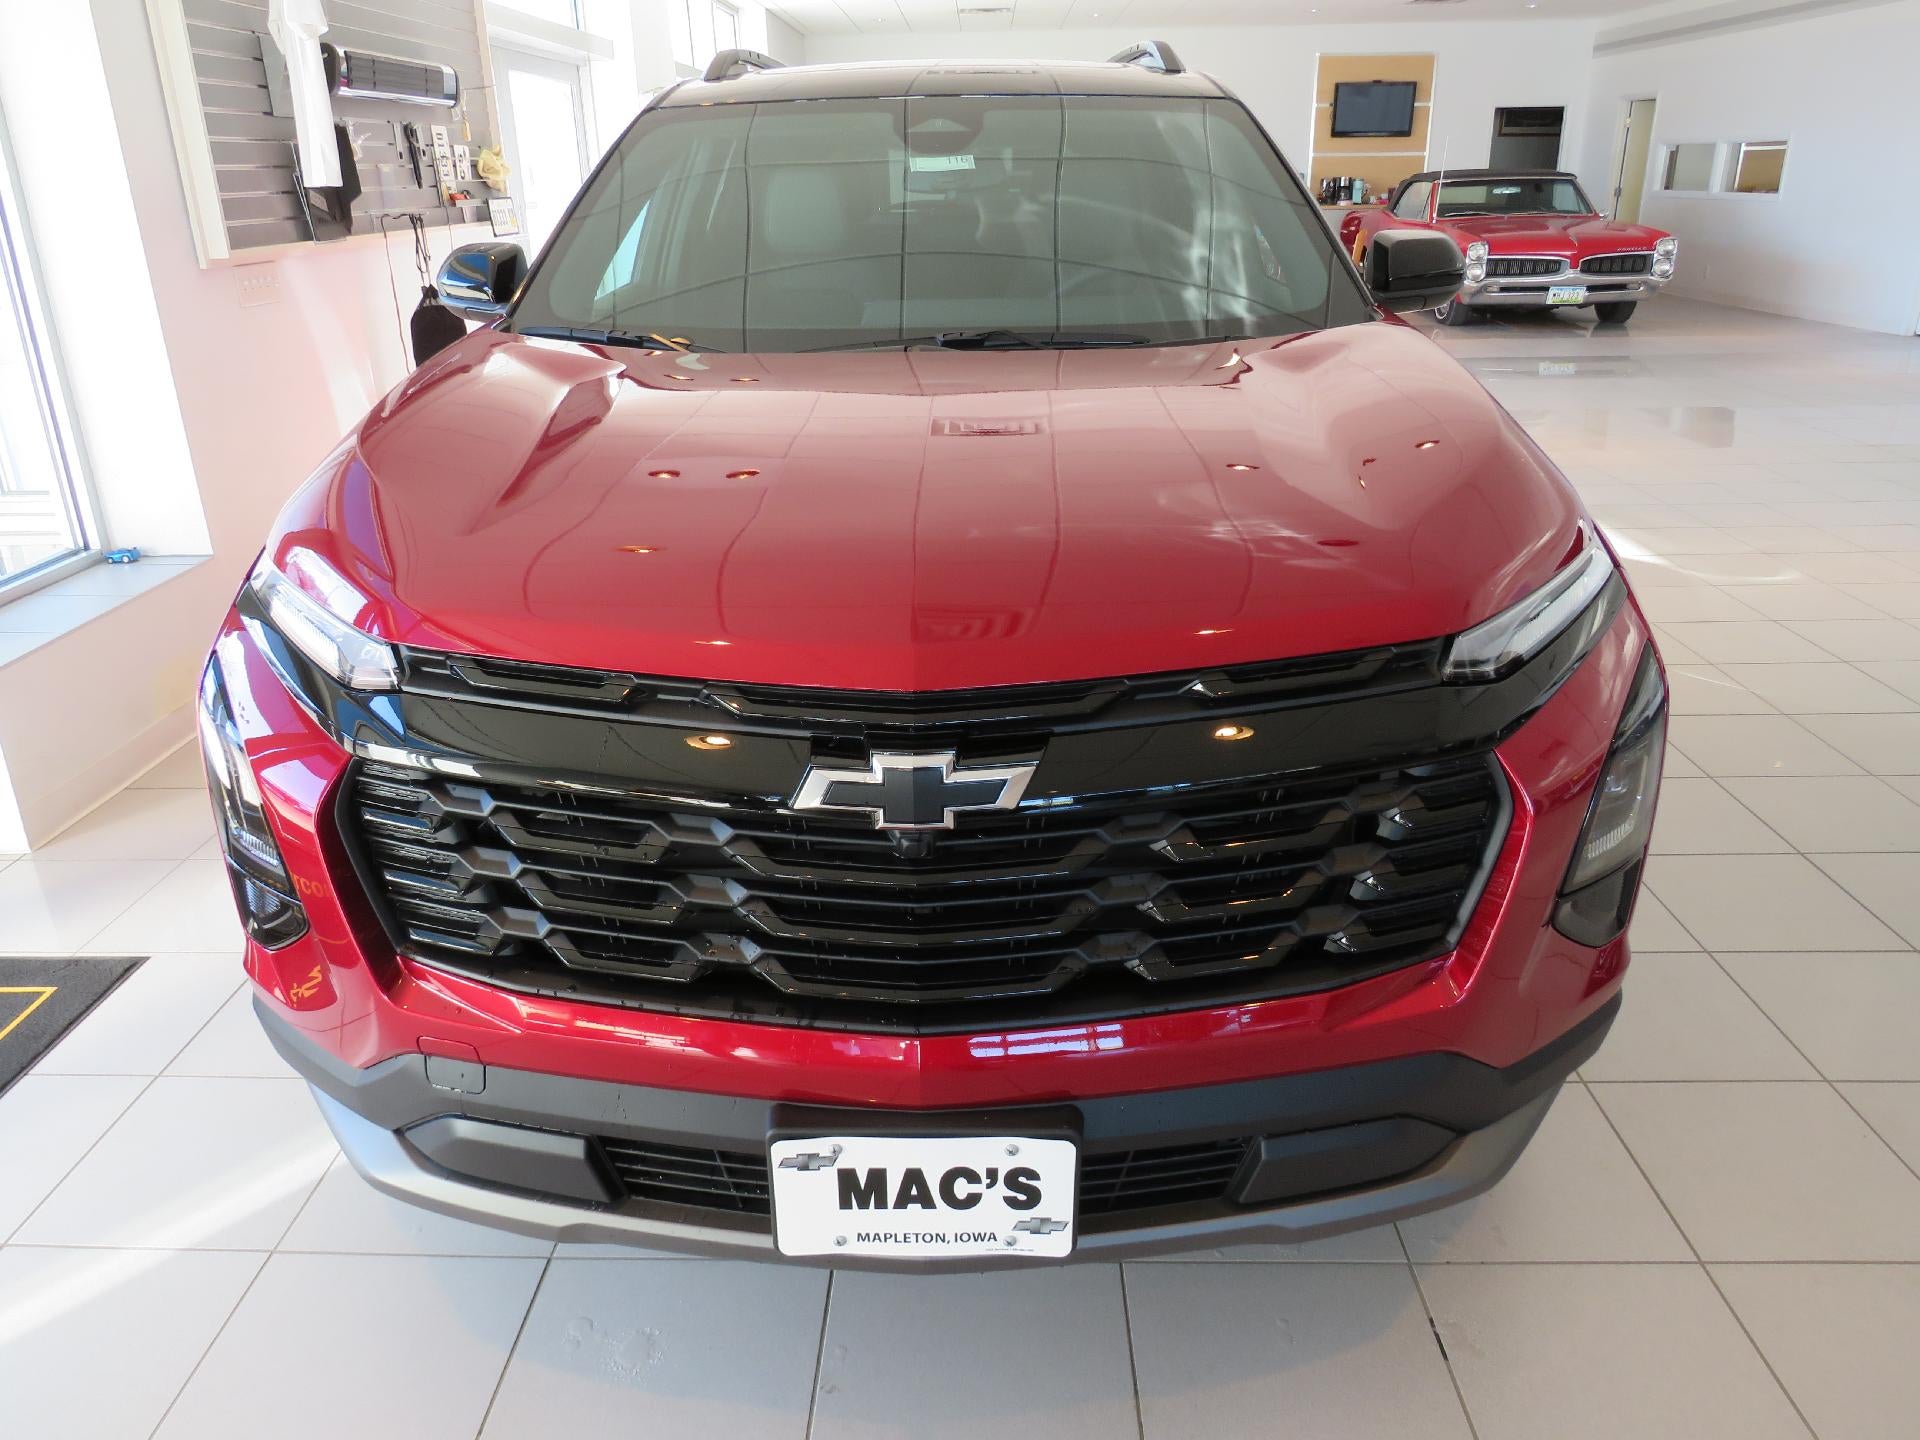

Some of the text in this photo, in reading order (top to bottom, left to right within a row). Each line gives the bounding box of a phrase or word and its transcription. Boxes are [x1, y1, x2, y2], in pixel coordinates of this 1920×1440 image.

[837, 1166, 1042, 1210] MAC'S
[856, 1232, 998, 1244] MAPLETON, IOWA
